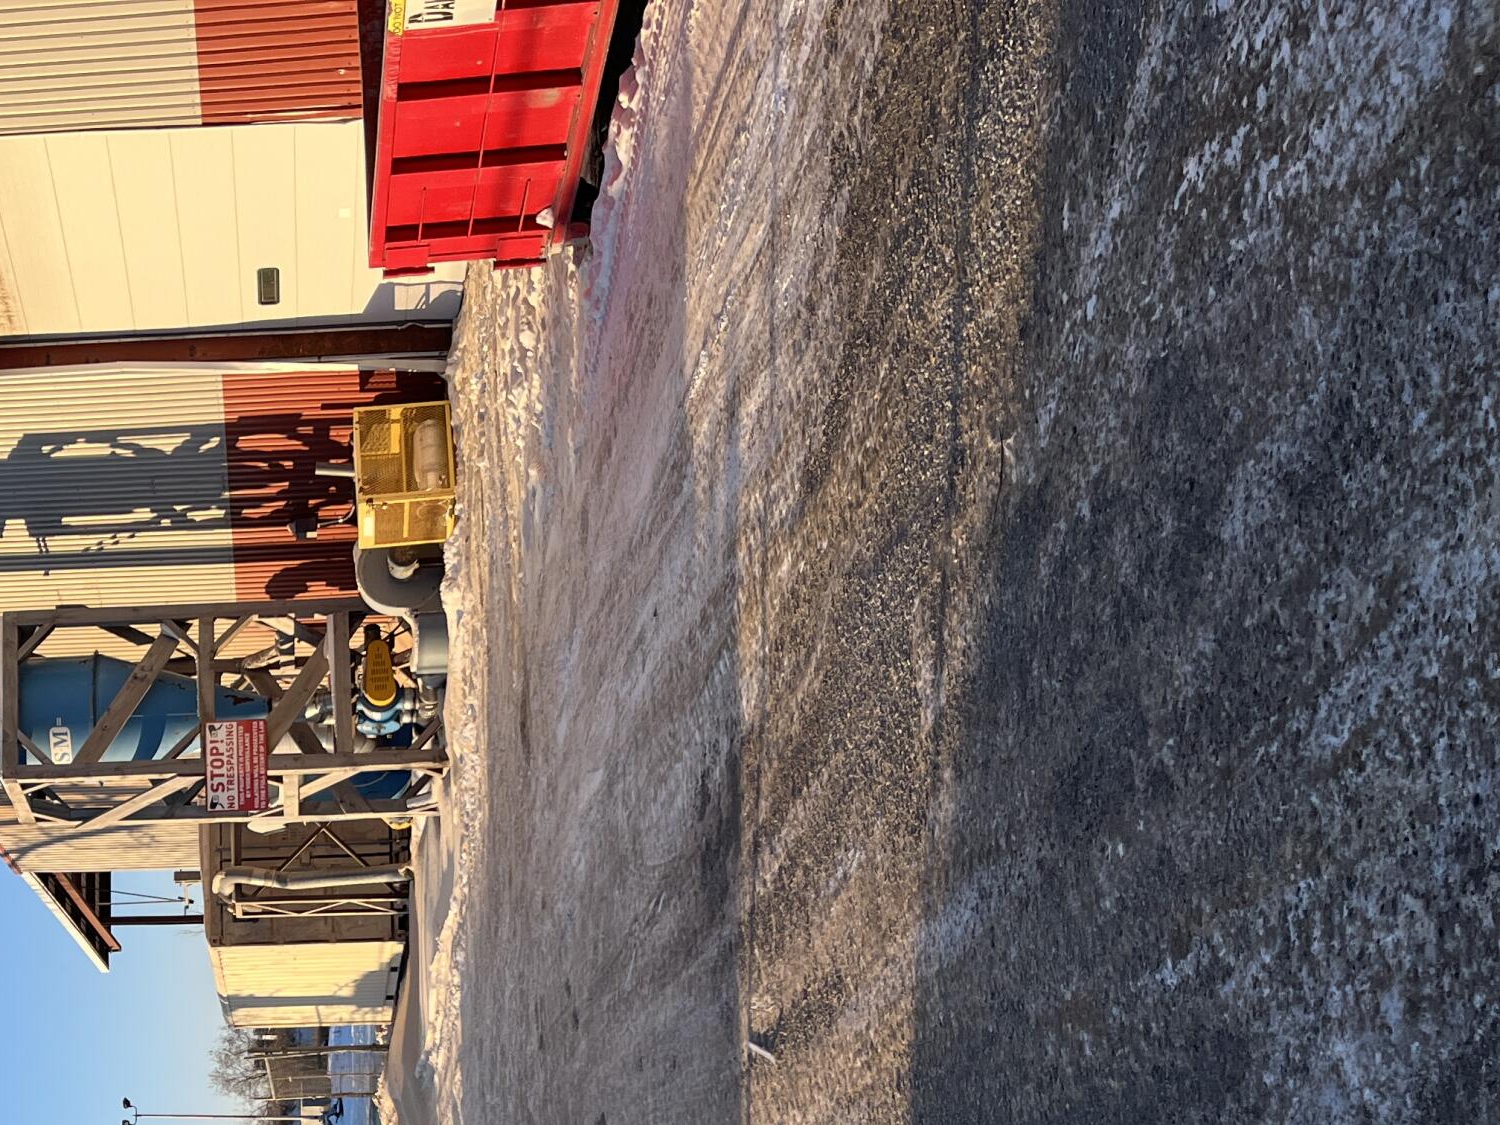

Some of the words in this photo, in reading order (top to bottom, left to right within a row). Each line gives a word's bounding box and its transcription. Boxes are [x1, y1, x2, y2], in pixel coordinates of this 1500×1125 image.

[394, 2, 403, 20] NOT
[393, 22, 401, 33] DO
[259, 745, 265, 753] OF
[226, 723, 235, 792] TRESPASSING
[210, 739, 225, 793] STOP!
[246, 790, 251, 798] BY
[227, 795, 235, 808] NO
